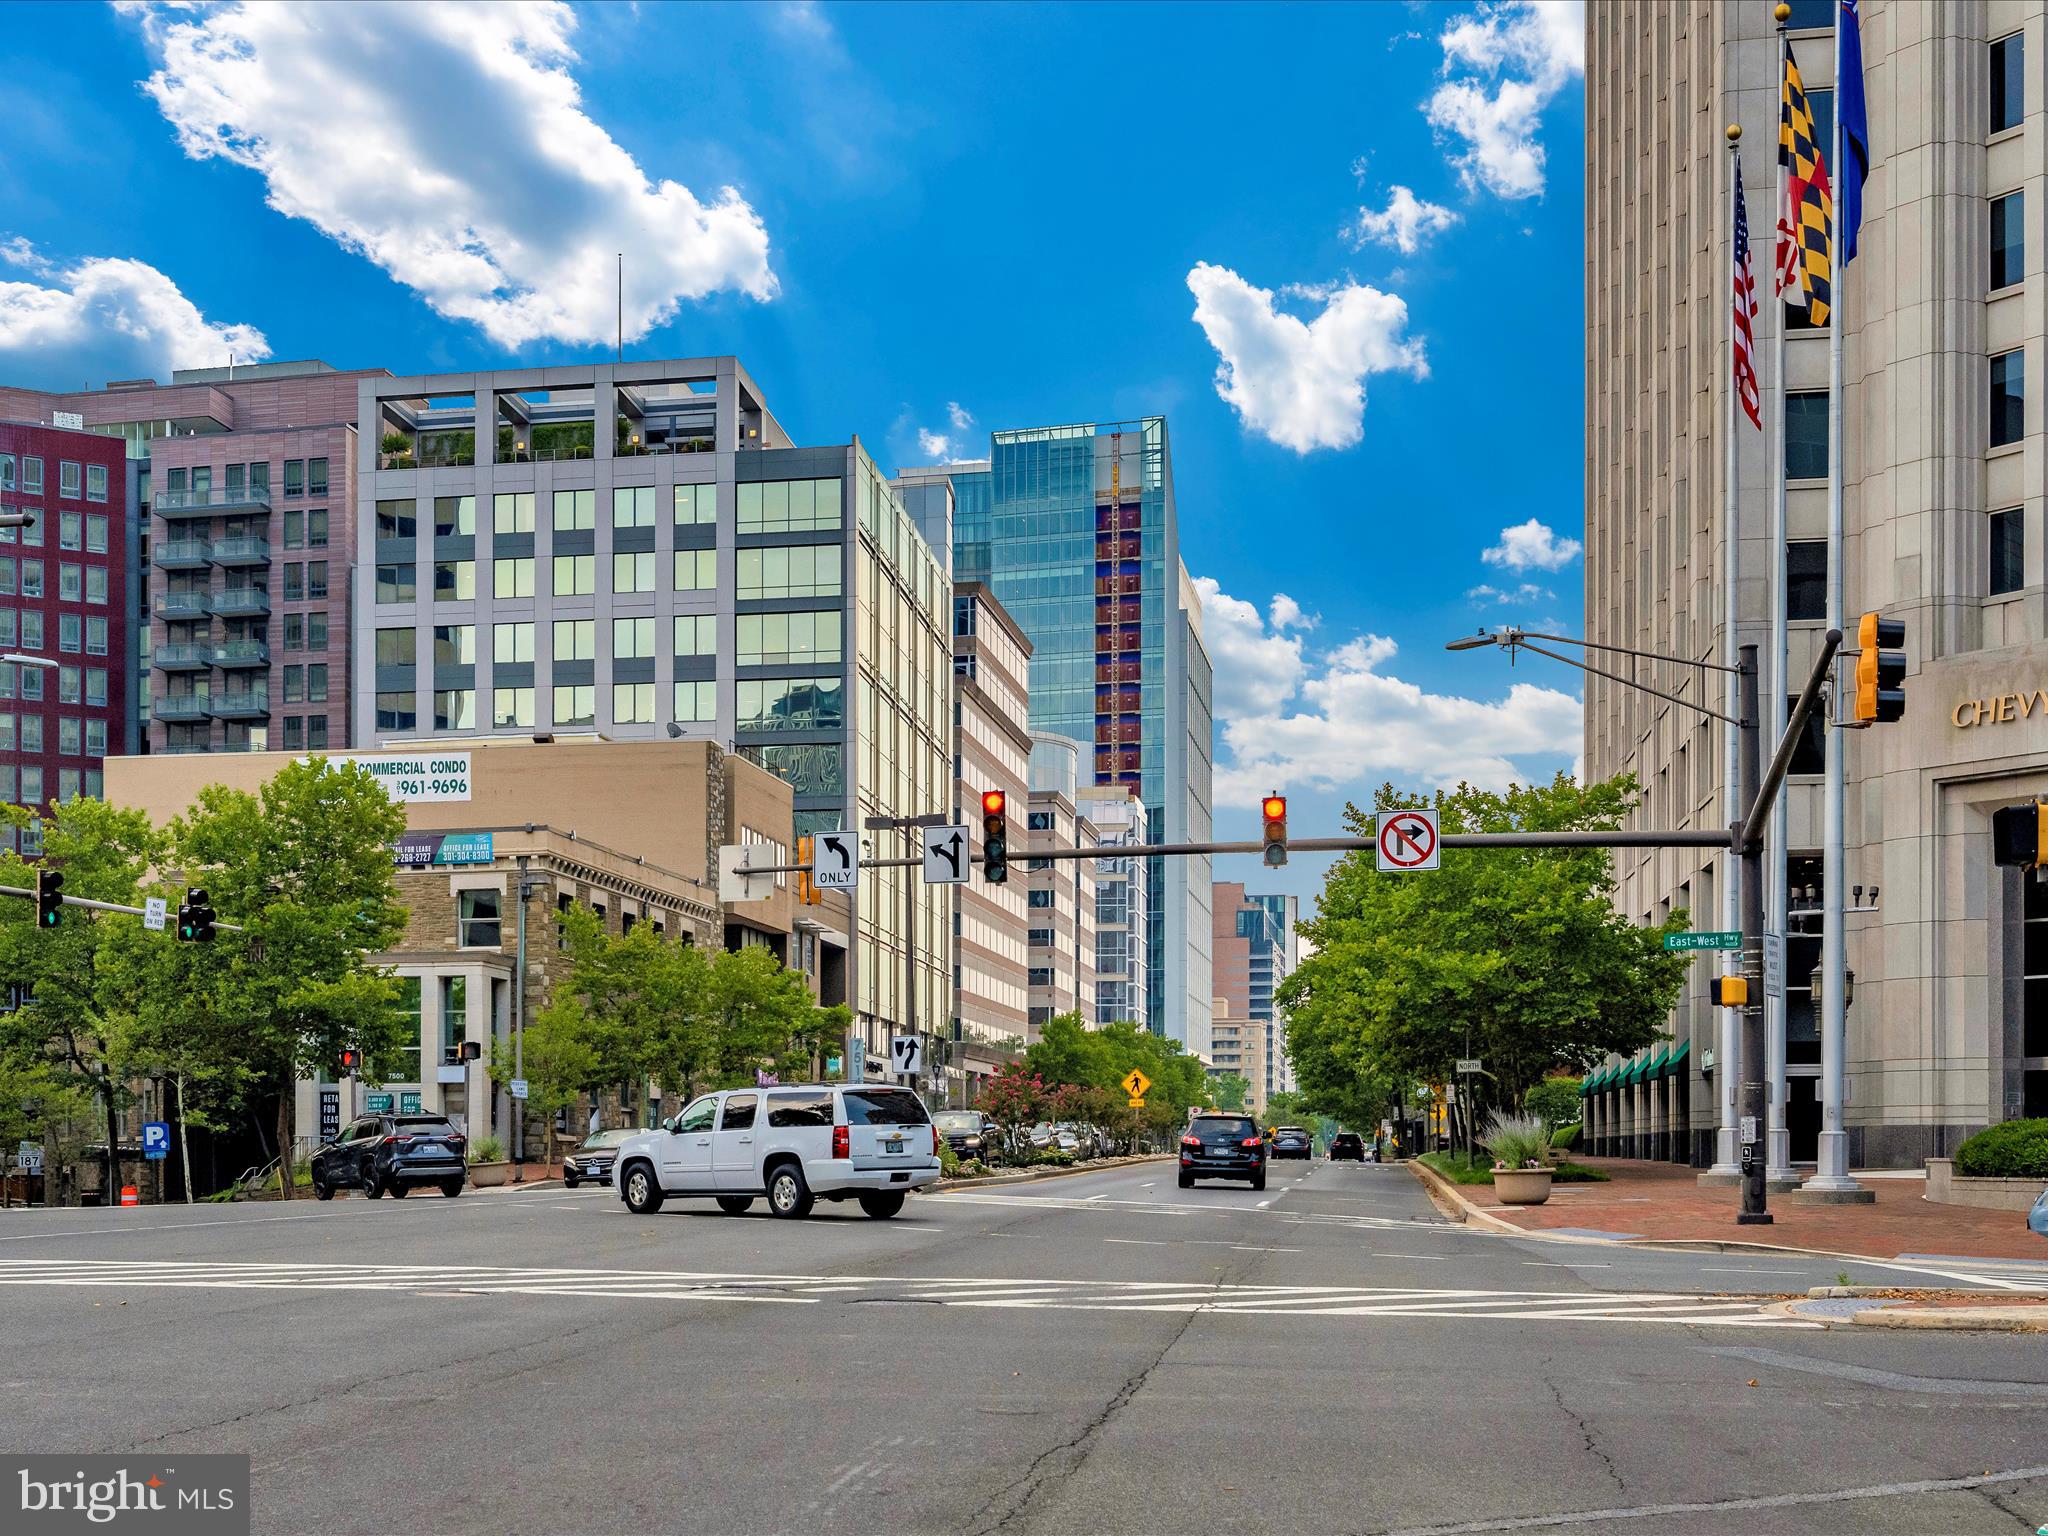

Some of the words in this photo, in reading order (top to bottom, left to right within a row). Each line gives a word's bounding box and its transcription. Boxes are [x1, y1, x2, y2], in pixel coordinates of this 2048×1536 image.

[358, 761, 426, 776] COMMERCIAL
[430, 760, 467, 774] CONDO
[401, 779, 467, 795] 961-9696
[416, 845, 431, 853] LEASE
[443, 844, 461, 852] OFFICE
[474, 843, 489, 851] LEASE
[820, 872, 851, 883] ONLY
[1670, 936, 1719, 947] East-West
[1724, 934, 1738, 943] Hwy
[323, 1094, 339, 1103] RETA
[403, 1096, 421, 1104] OFFIC
[323, 1104, 336, 1113] FOR
[323, 1115, 339, 1124] LEAS
[146, 1126, 164, 1146] P
[20, 1156, 39, 1166] 187
